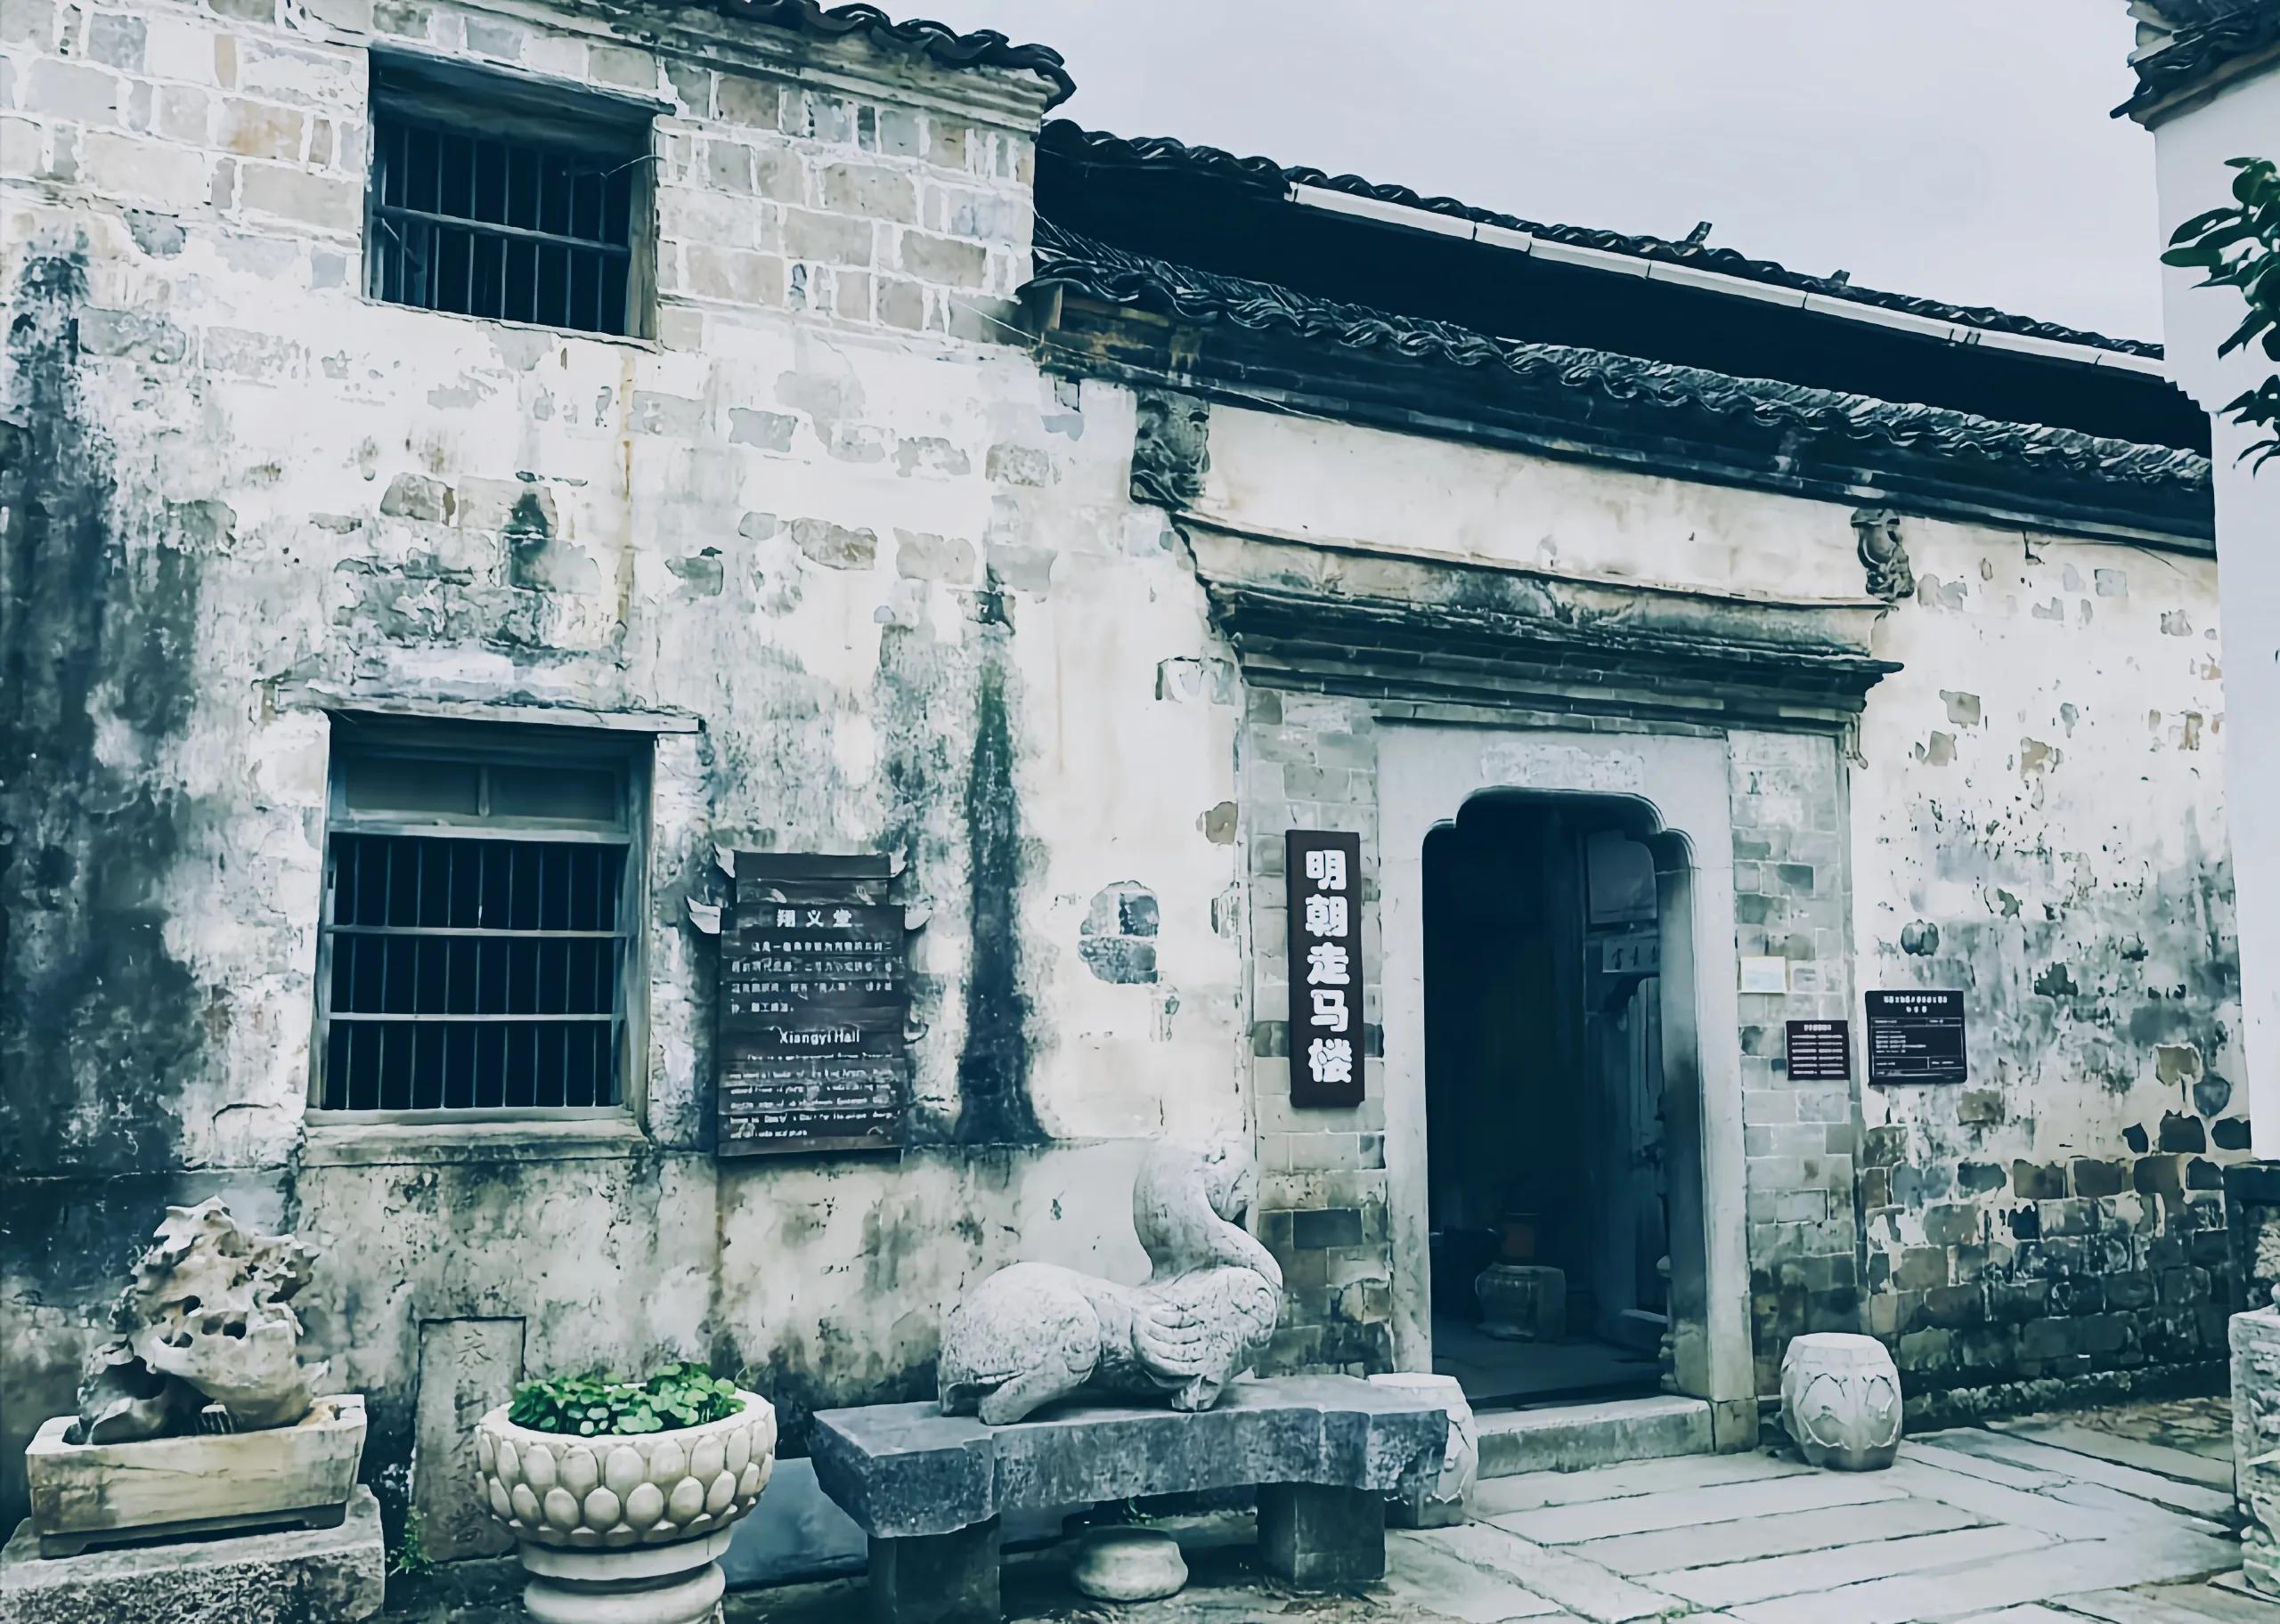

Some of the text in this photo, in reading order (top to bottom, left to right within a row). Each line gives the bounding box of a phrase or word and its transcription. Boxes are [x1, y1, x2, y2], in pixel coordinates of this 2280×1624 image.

[1305, 849, 1353, 1084] 明朝走马楼
[835, 1027, 860, 1043] Hall
